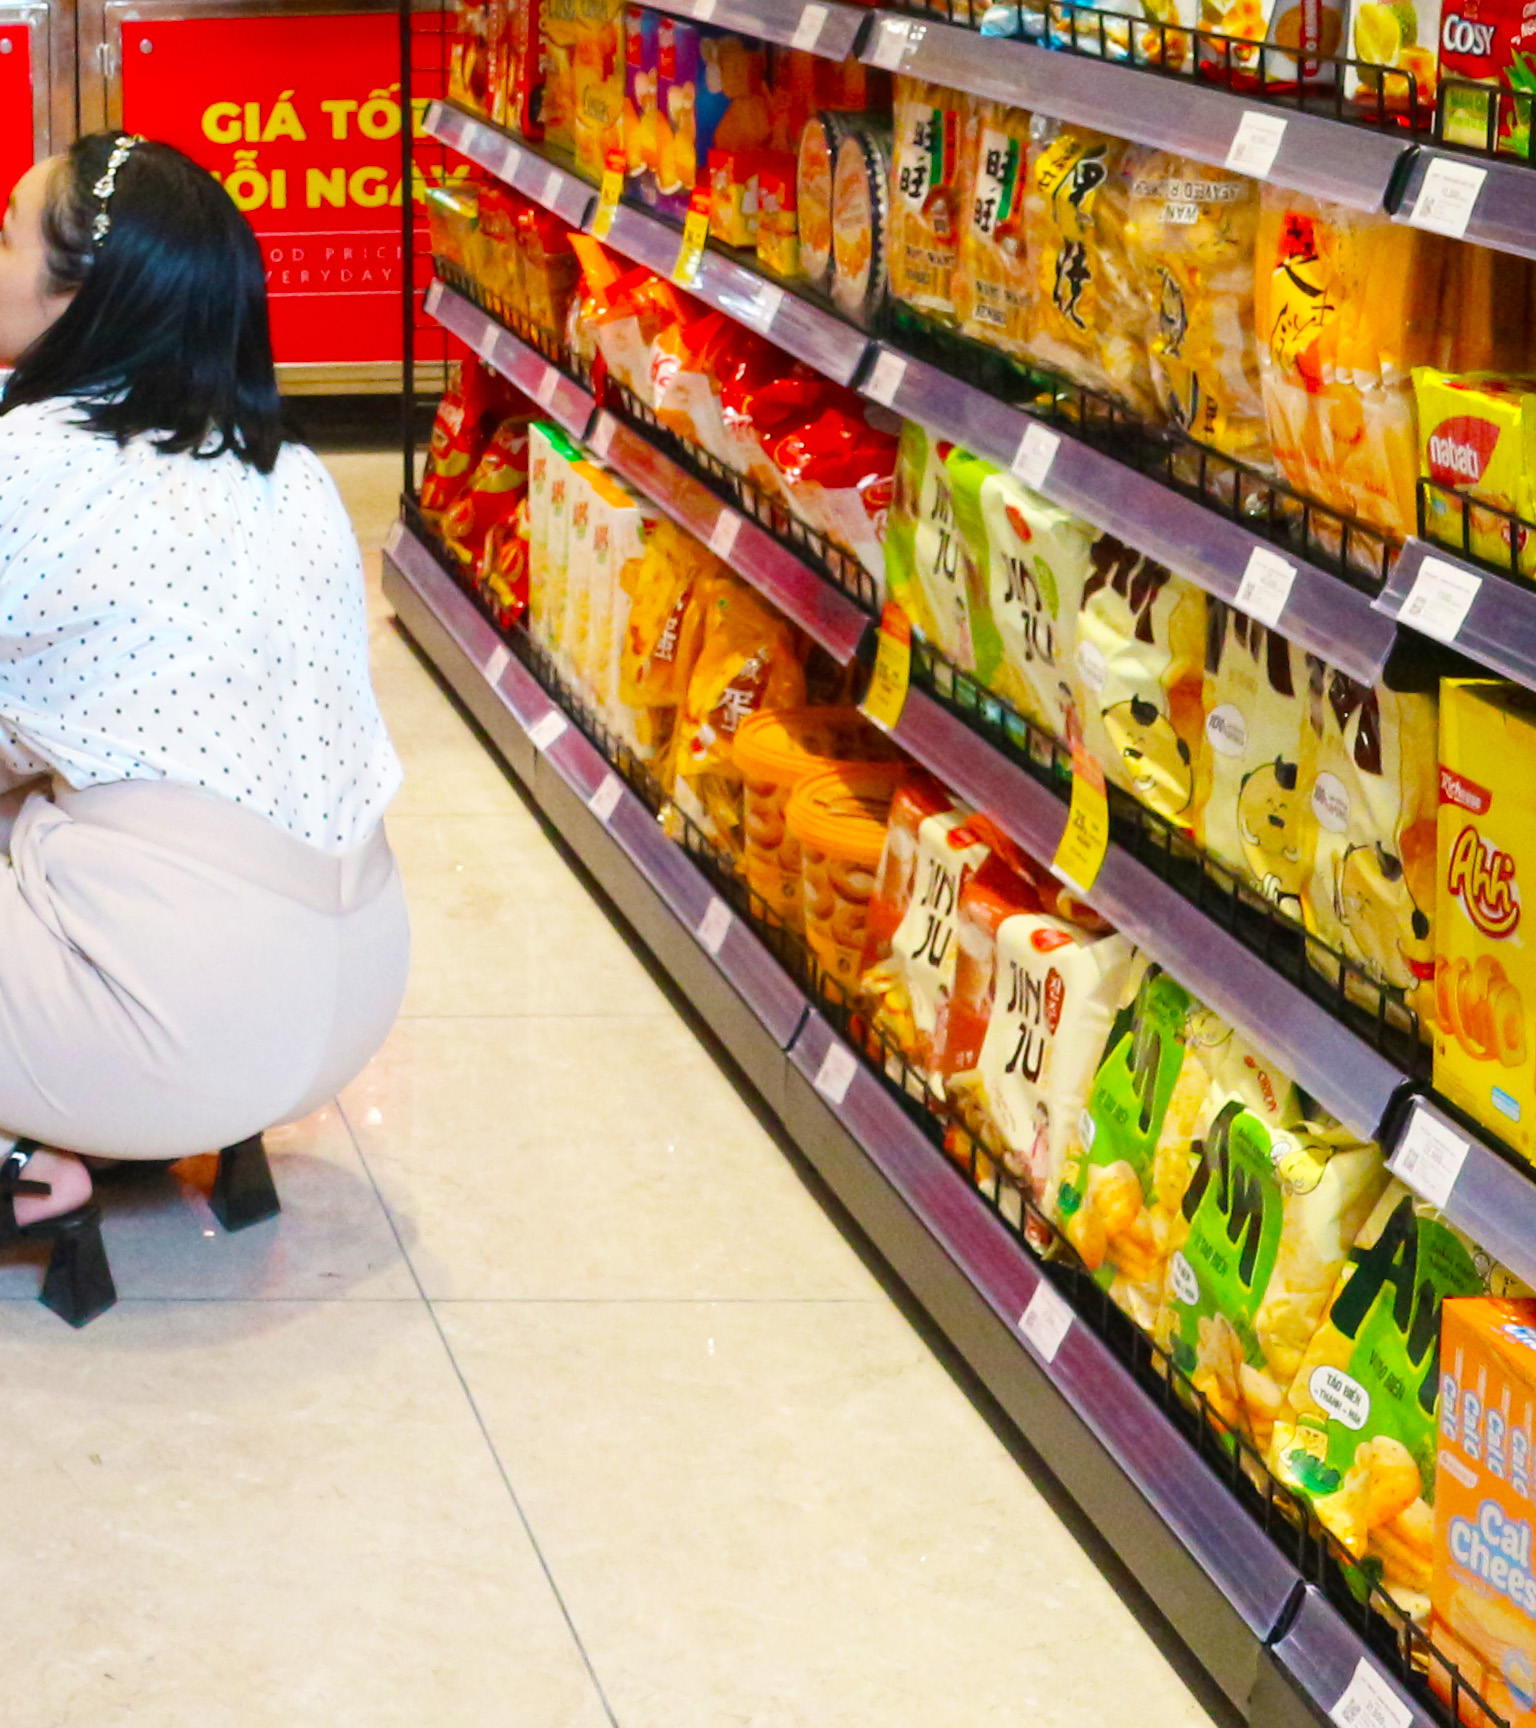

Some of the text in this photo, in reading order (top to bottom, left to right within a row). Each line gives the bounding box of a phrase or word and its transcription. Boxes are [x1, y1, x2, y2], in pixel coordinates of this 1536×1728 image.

[1443, 16, 1495, 57] COSY
[201, 90, 307, 144] GIÁ
[212, 149, 286, 212] ỖI
[265, 268, 392, 283] VERYDAY
[1429, 432, 1479, 480] nabati
[1002, 551, 1043, 612] JIN
[1023, 611, 1054, 665] JU
[921, 859, 956, 912] JIN
[1007, 958, 1043, 1025] JIN
[1006, 1021, 1045, 1084] JU
[1480, 1498, 1530, 1567] Cal
